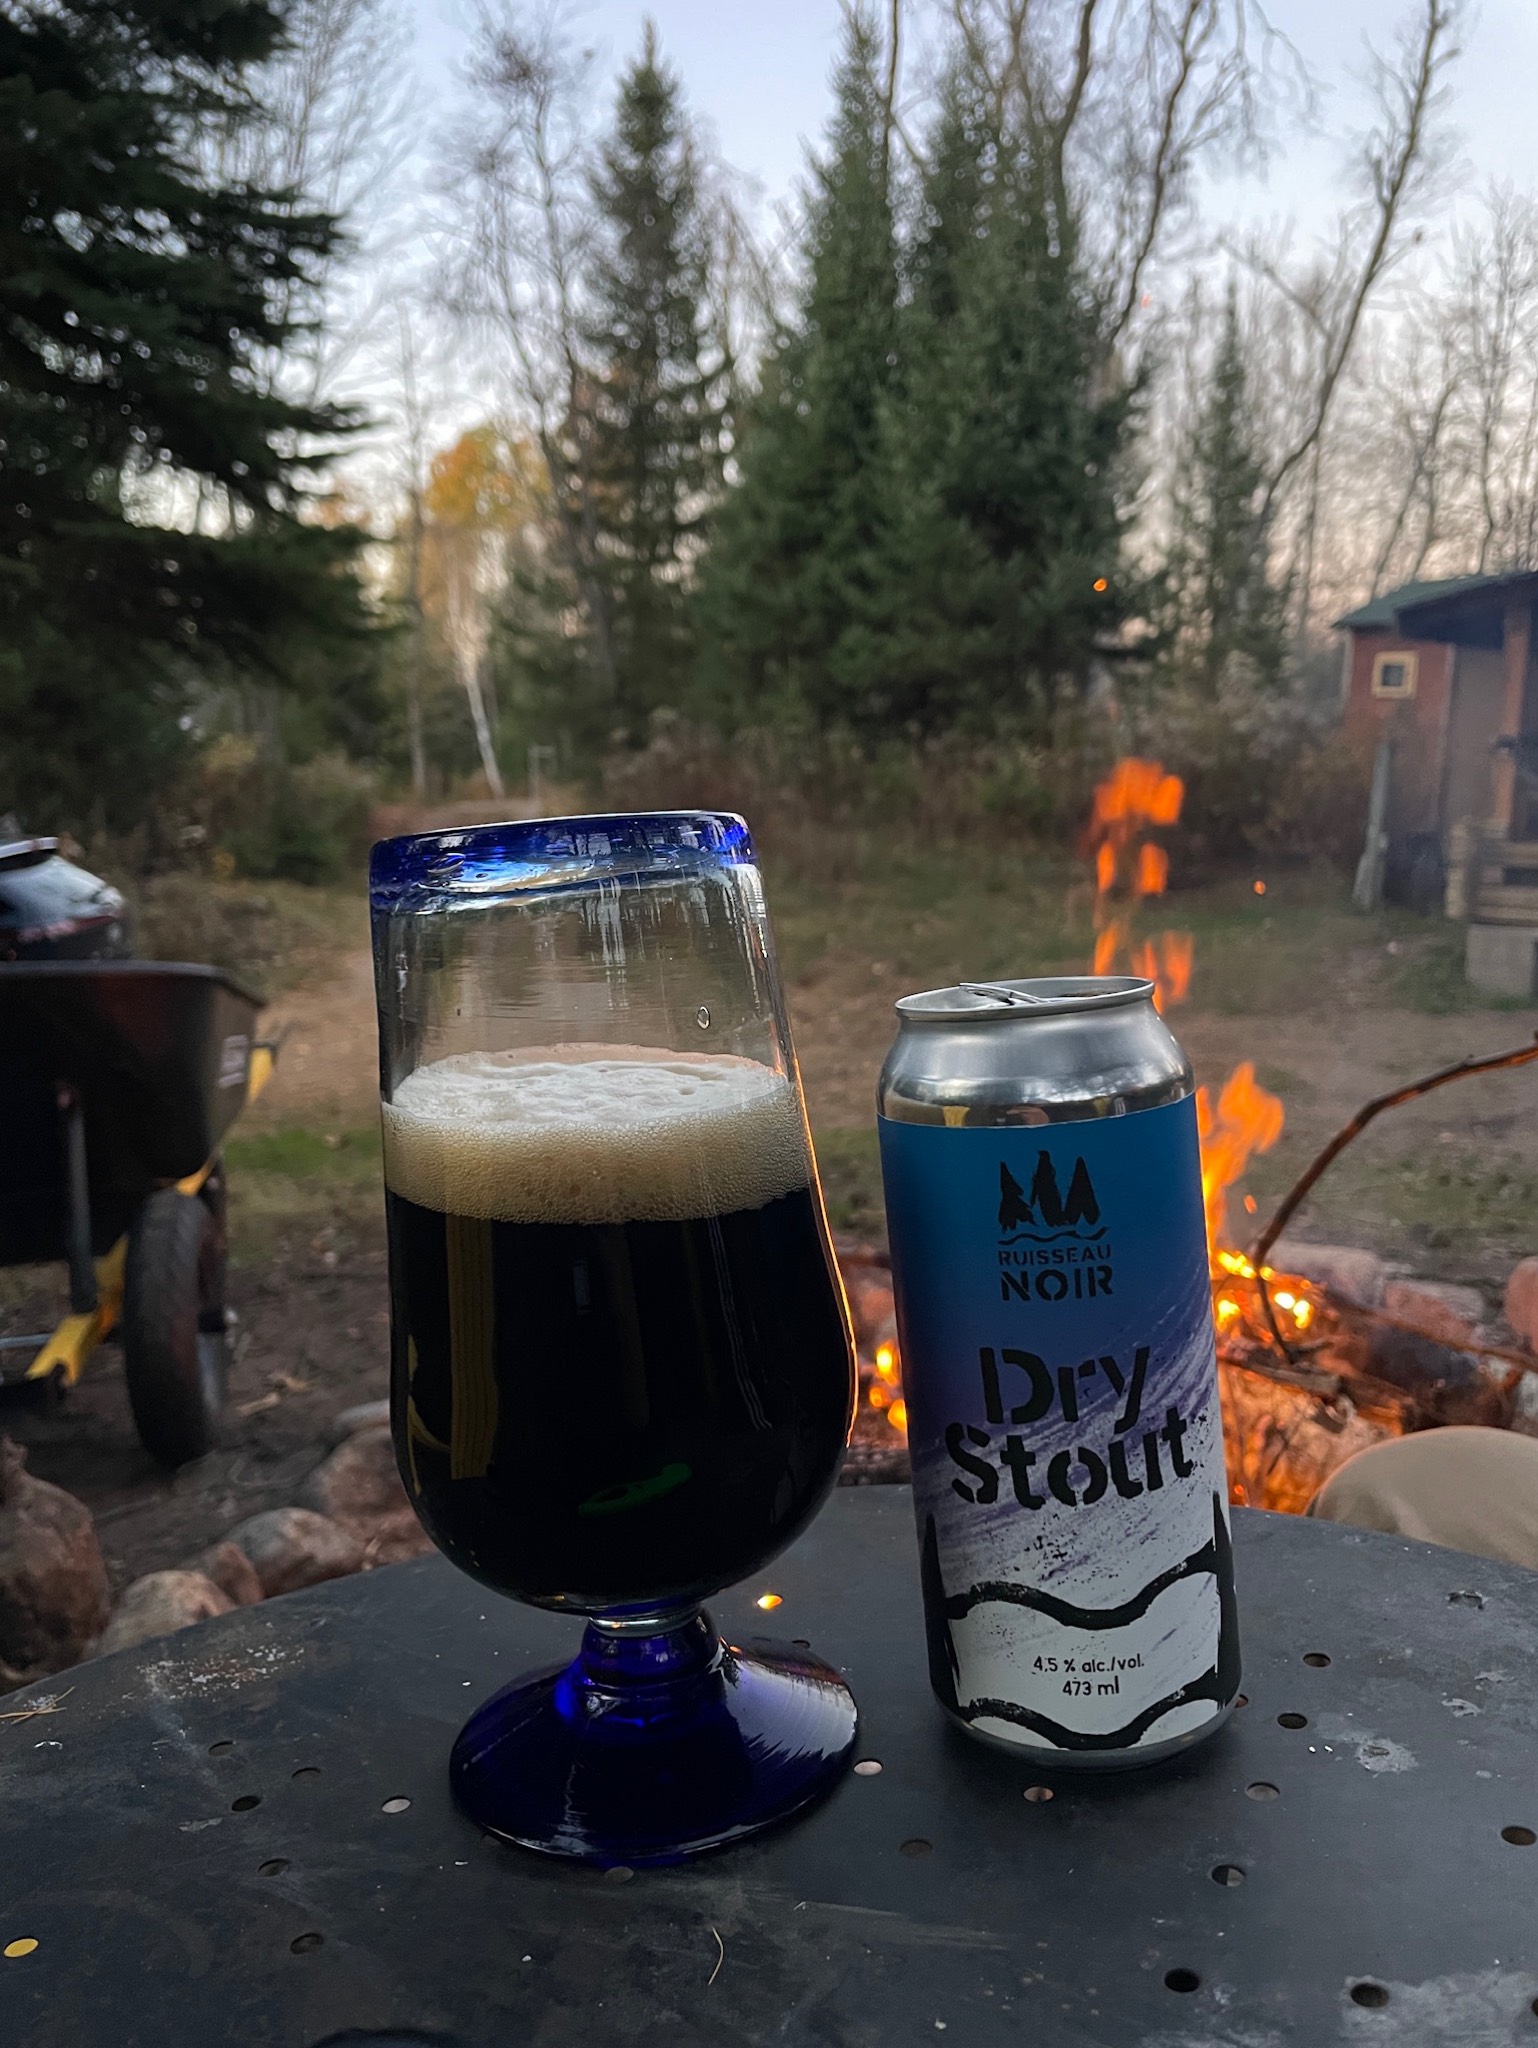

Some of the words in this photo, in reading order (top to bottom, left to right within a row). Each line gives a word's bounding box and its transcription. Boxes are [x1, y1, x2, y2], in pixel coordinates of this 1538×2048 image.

[997, 1243, 1112, 1267] RUISSEAU
[1000, 1265, 1115, 1302] NOIR
[980, 1345, 1151, 1434] Dry
[944, 1407, 1194, 1511] Stout
[1063, 1658, 1076, 1673] %
[1081, 1653, 1145, 1673] alc./vol.
[1062, 1680, 1092, 1696] 473
[1097, 1675, 1120, 1695] ml
